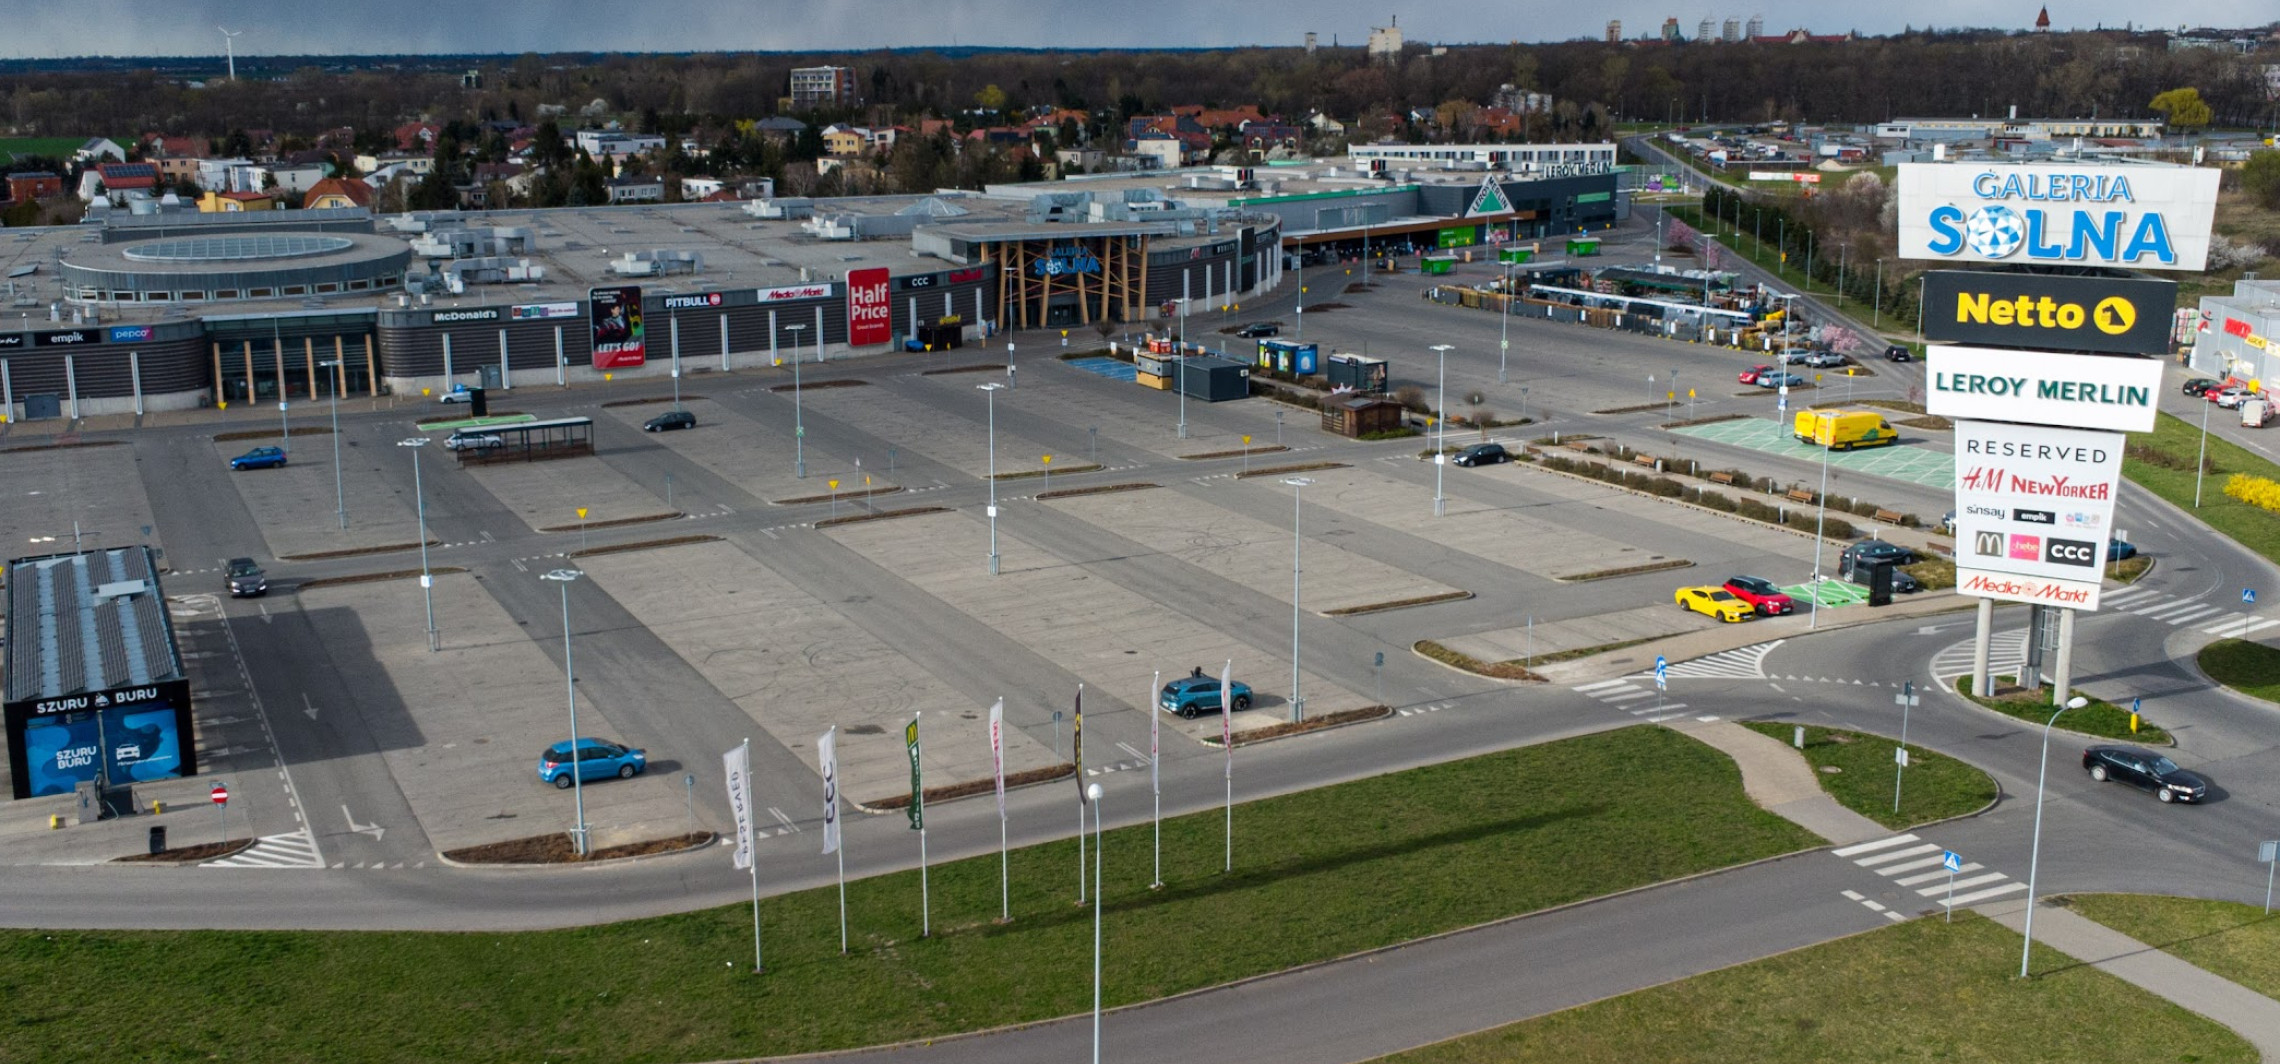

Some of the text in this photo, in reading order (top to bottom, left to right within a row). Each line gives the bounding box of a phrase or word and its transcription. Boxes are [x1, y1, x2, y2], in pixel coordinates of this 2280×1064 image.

[1545, 161, 1612, 178] LEROY MERLIN
[1488, 176, 1508, 209] MERLIN
[1973, 168, 2133, 202] GALERIA
[1472, 184, 1490, 212] LEROY
[1927, 203, 2176, 264] SOLNA
[911, 276, 929, 286] CCC
[665, 296, 710, 308] PITBULL
[850, 283, 887, 305] Half
[434, 309, 498, 322] McDonald's
[851, 305, 888, 321] Price
[1957, 291, 2086, 331] Netto
[51, 332, 84, 344] empik
[115, 329, 148, 339] pepco
[1936, 371, 2150, 407] LEROY MERLIN
[1967, 439, 2107, 464] RESERVED
[1962, 466, 2004, 493] H&M
[1966, 505, 2047, 523] sinsay empik
[2050, 544, 2090, 561] CCC
[1964, 575, 2089, 604] Media Markt
[36, 687, 157, 714] SZURU BURU
[56, 746, 97, 761] SZURU
[57, 755, 92, 770] BURU
